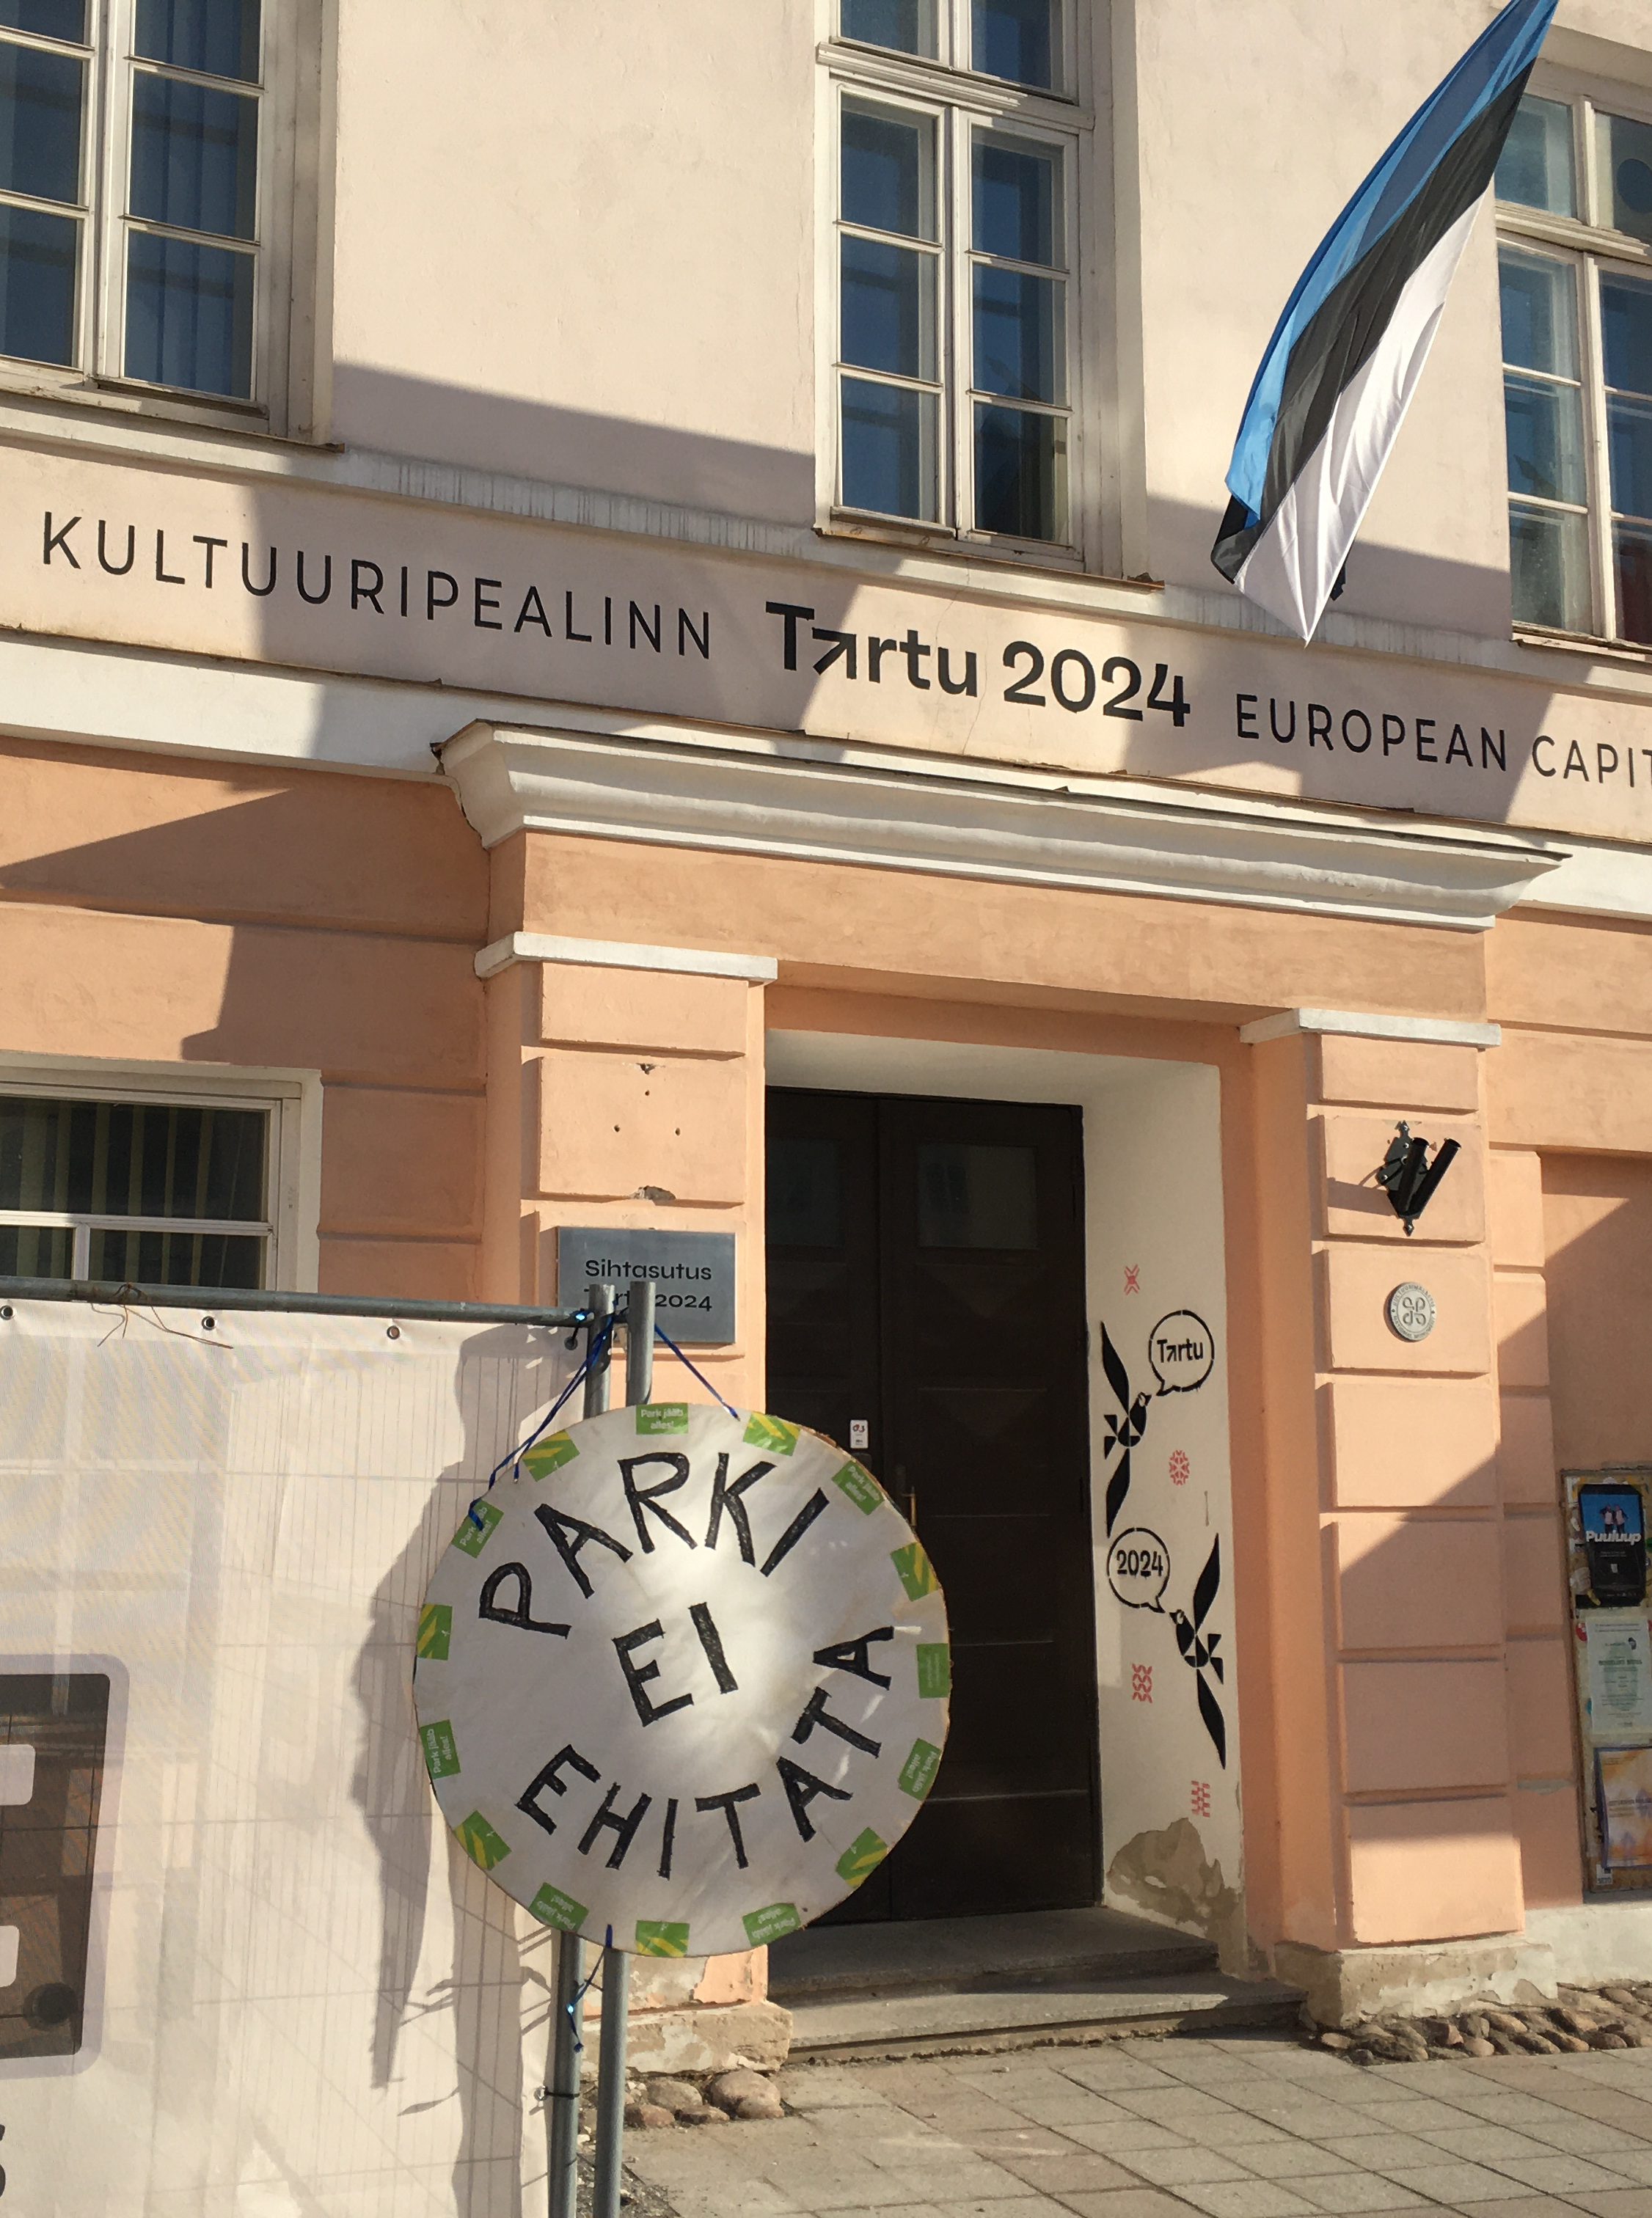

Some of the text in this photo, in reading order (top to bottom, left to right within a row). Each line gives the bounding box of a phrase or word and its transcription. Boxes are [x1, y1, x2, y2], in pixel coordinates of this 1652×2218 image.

[42, 511, 711, 660] KULTUURIPEALINN
[1003, 640, 1190, 728] 2024
[1235, 693, 1507, 772] EUROPEAN
[585, 1259, 712, 1281] Sihtasutus
[654, 1294, 713, 1312] 2024
[640, 1409, 662, 1418] Park
[478, 1451, 830, 1639] PARKI
[1116, 1549, 1163, 1578] 2024
[611, 1601, 739, 1728] EI
[433, 1750, 442, 1774] Park
[514, 1625, 895, 1880] EHITATA
